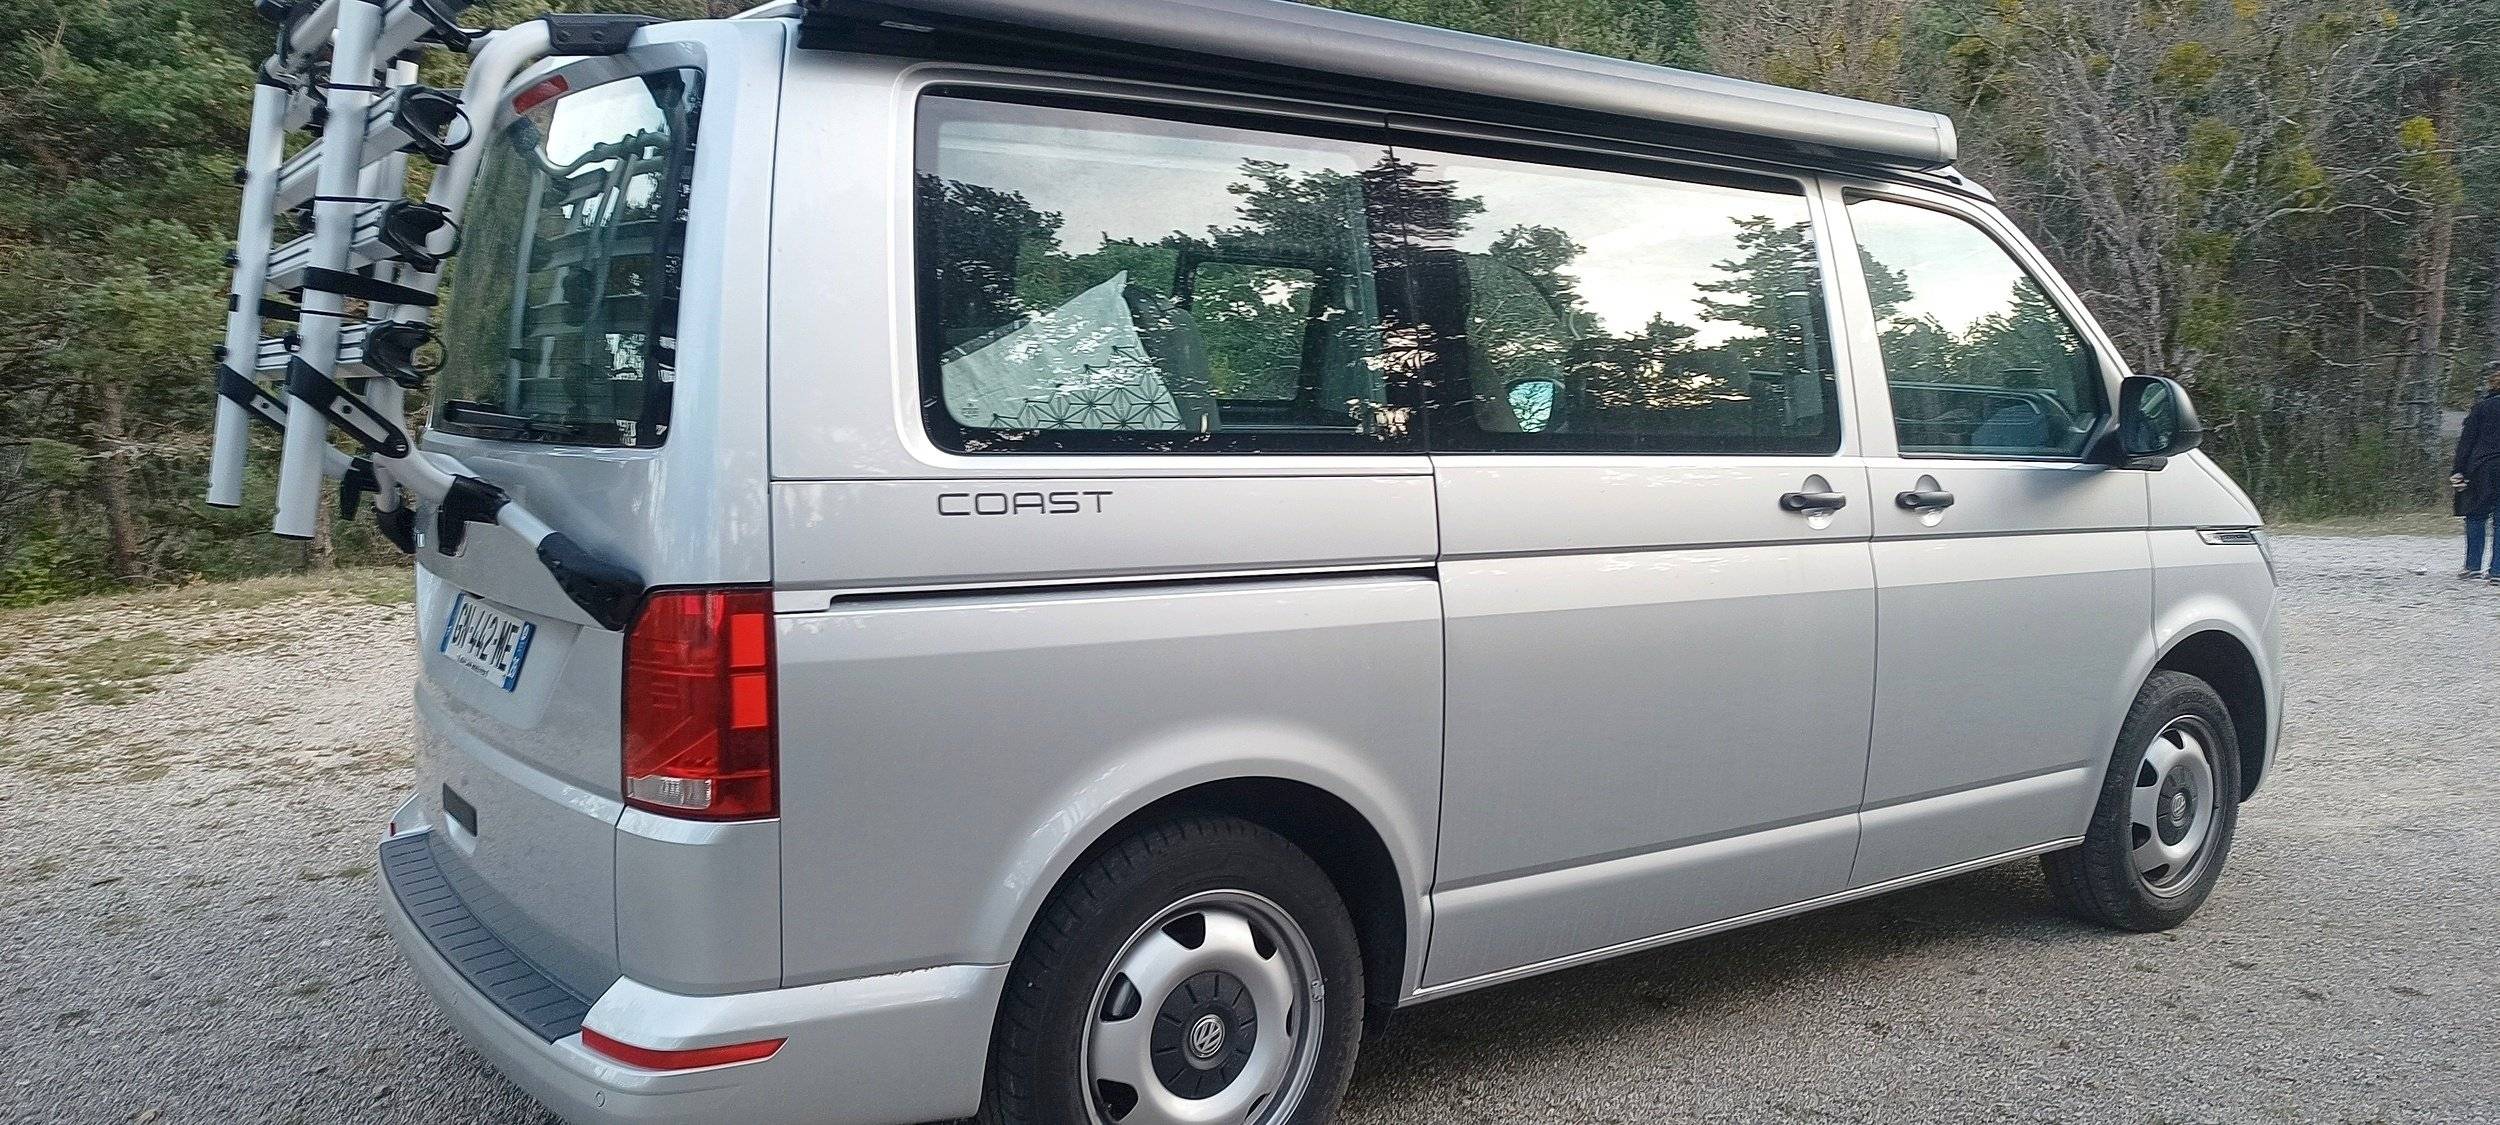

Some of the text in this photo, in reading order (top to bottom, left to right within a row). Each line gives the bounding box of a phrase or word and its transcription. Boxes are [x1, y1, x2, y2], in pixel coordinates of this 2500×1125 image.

[937, 491, 1113, 516] COAST
[451, 602, 520, 671] GN-442-ME
[1191, 1015, 1225, 1057] VW
